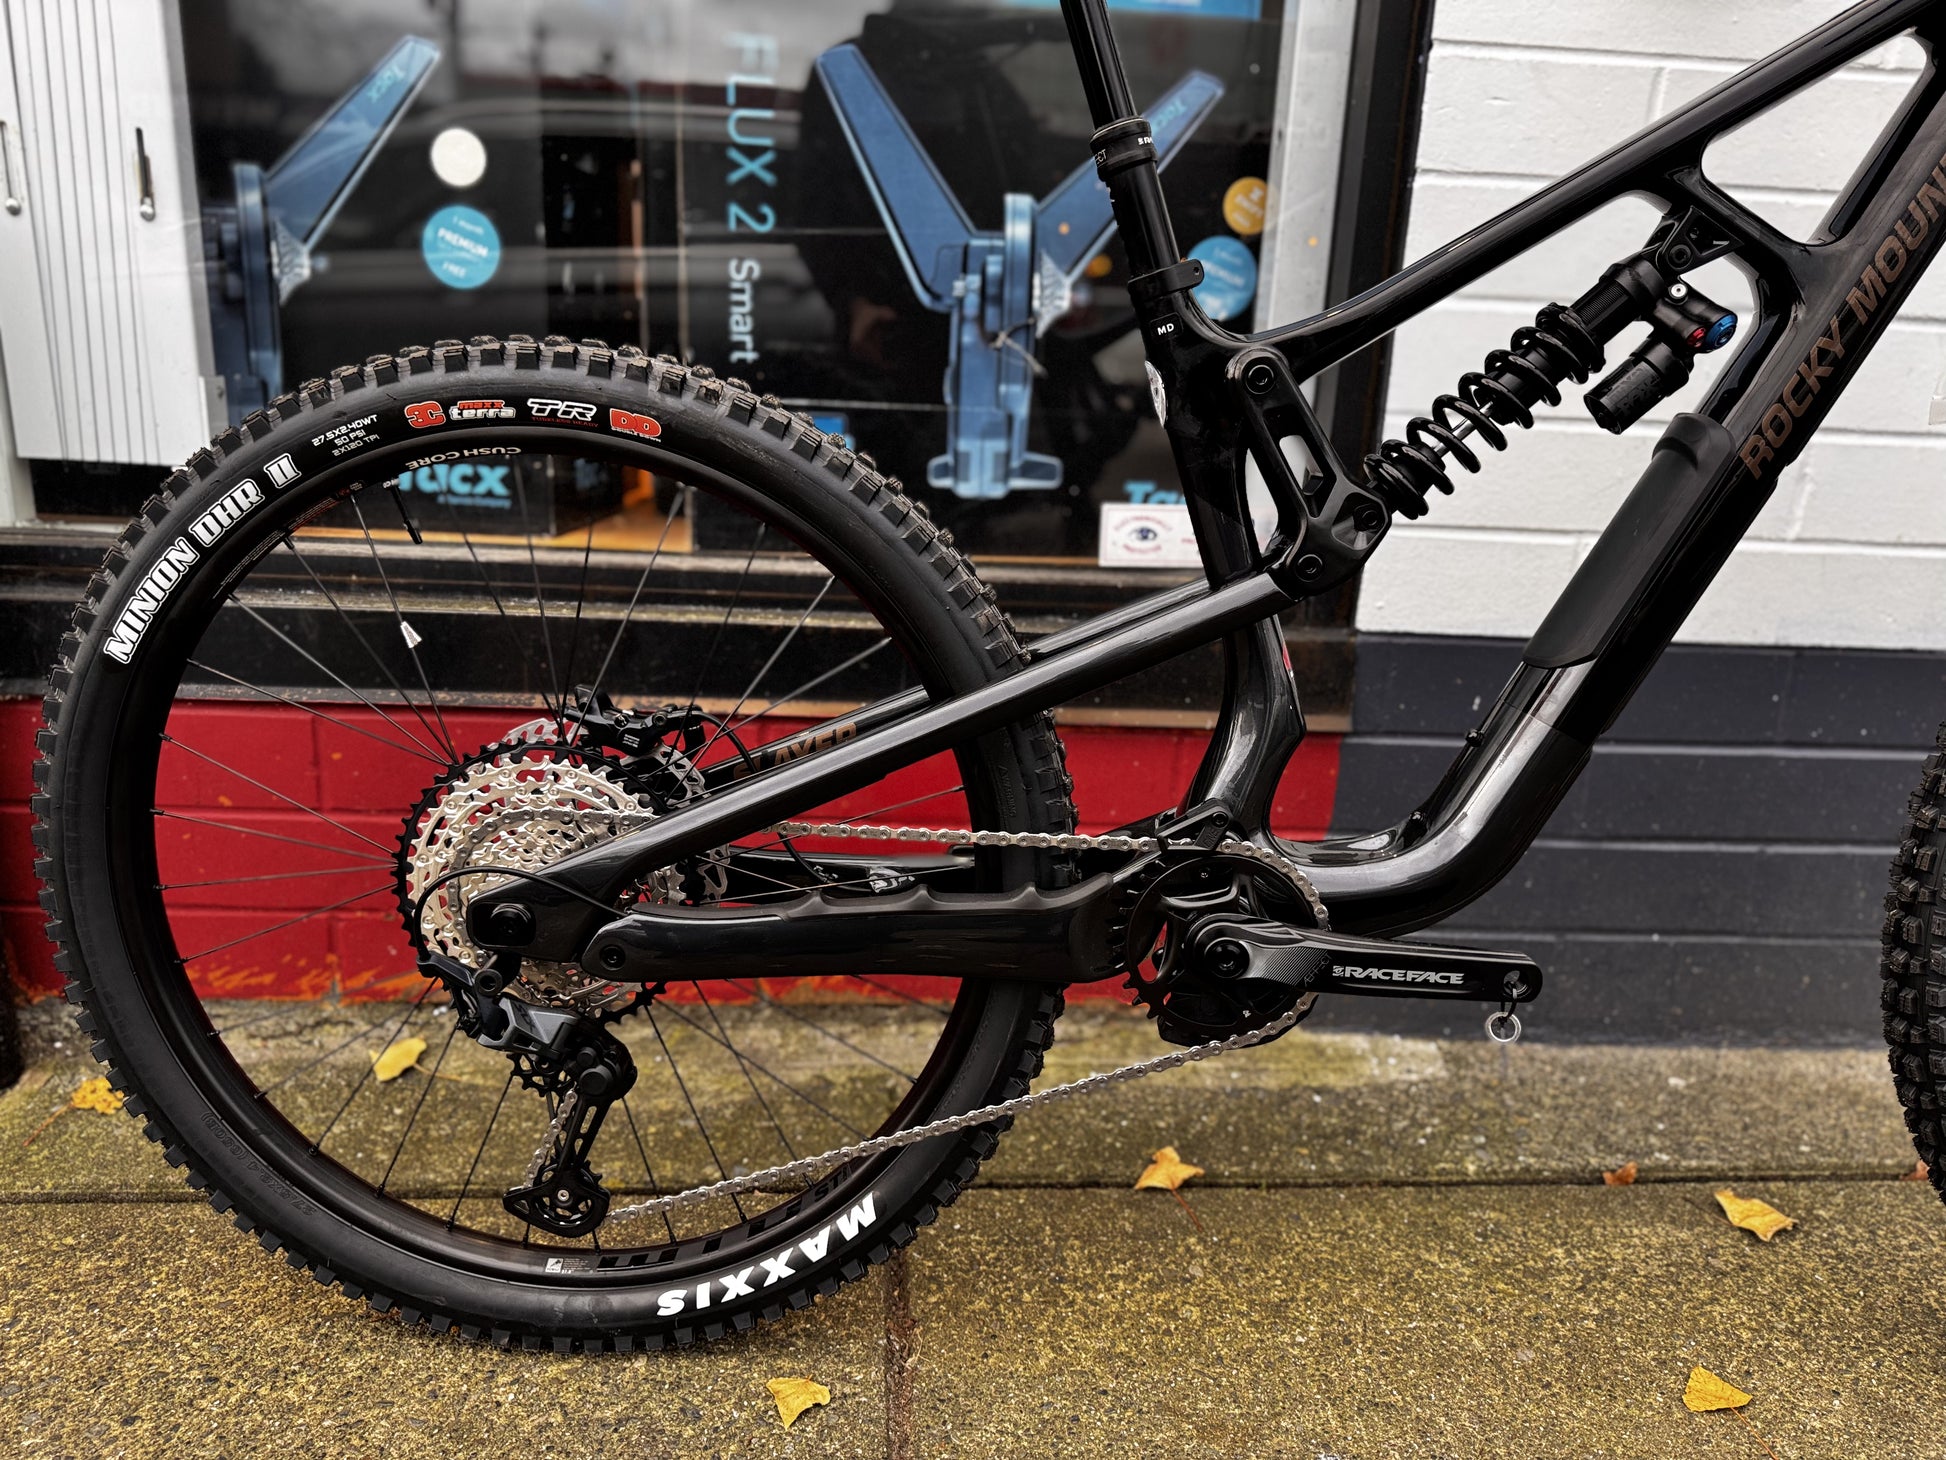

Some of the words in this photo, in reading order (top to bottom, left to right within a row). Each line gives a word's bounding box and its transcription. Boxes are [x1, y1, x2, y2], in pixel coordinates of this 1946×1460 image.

[725, 31, 779, 187] FLUX
[727, 201, 776, 233] 2
[729, 258, 761, 364] Smart
[1739, 315, 1846, 481] ROCKY
[1846, 152, 1946, 327] MOUN
[1157, 323, 1175, 336] MD
[403, 400, 447, 429] 3C
[449, 406, 516, 421] terra
[527, 398, 597, 421] TR
[609, 408, 662, 437] DD
[331, 439, 364, 457] 2X120
[364, 433, 381, 445] TPI
[350, 429, 366, 442] PSI
[405, 451, 460, 470] CORE
[463, 447, 521, 457] CUSH
[104, 537, 200, 664] MINION
[188, 478, 265, 548] DHR
[1344, 966, 1464, 985] RACEFACE
[656, 1191, 878, 1317] MAXXIS
